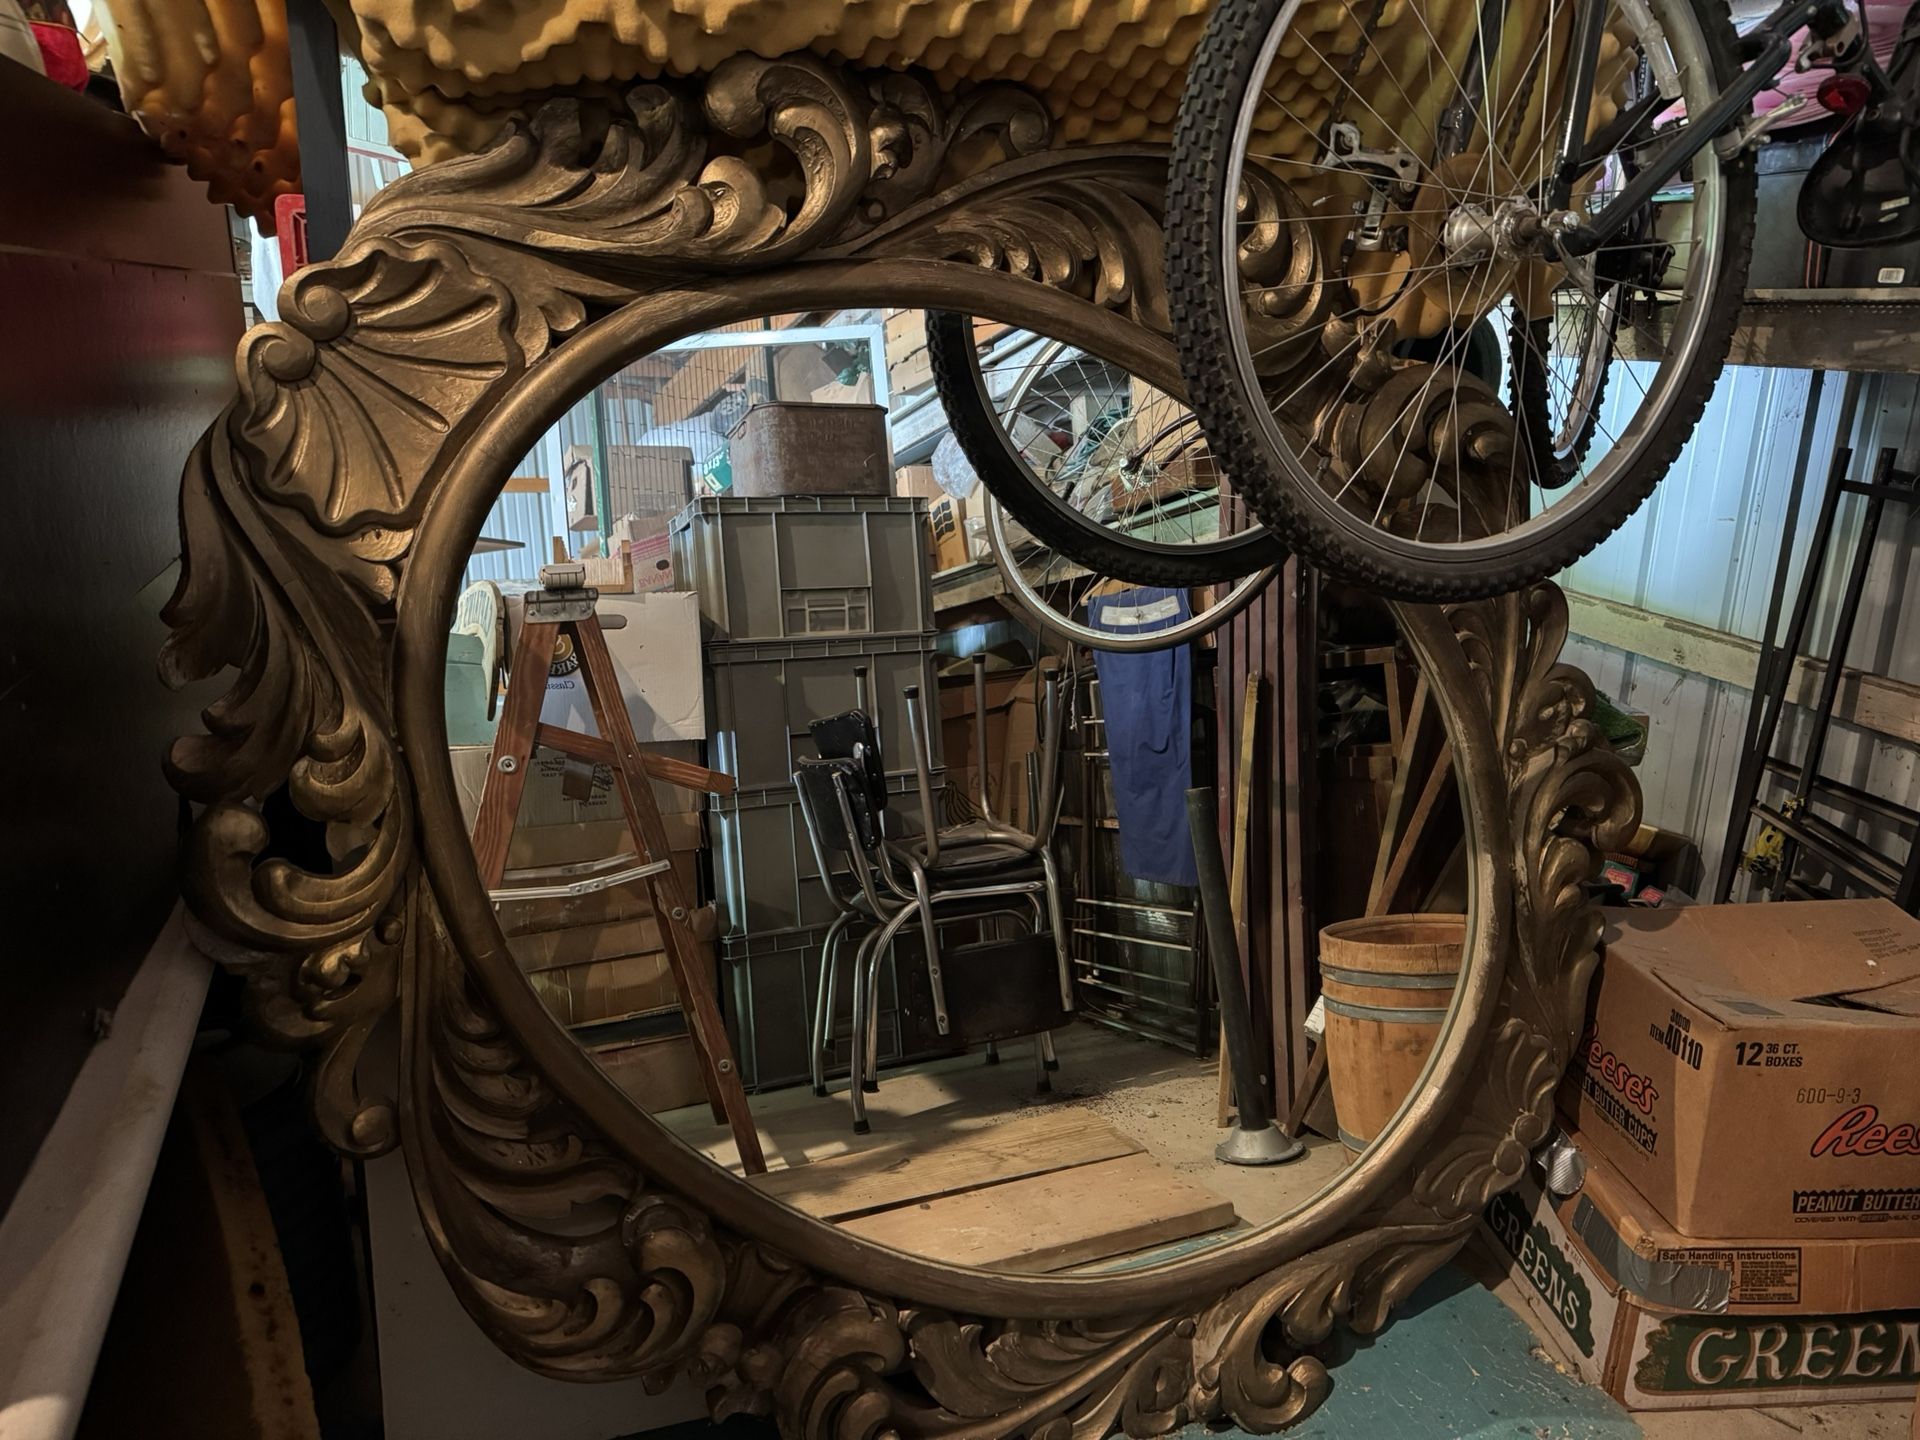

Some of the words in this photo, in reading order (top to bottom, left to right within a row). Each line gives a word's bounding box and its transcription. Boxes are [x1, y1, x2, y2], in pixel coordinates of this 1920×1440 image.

[1649, 1023, 1665, 1045] ITEM
[1664, 1023, 1704, 1071] 40110
[1735, 1041, 1764, 1066] 12
[1766, 1043, 1779, 1054] 36
[1783, 1043, 1800, 1054] CT.
[1765, 1056, 1803, 1067] BOXES
[1594, 1086, 1625, 1126] BUTTER
[1628, 1117, 1655, 1151] CUPS
[1810, 1104, 1920, 1158] Ree
[1796, 1195, 1858, 1212] PEANUT
[1862, 1194, 1920, 1211] BUTTER
[1491, 1197, 1580, 1329] GREENS
[1662, 1251, 1685, 1261] Safe
[1688, 1251, 1734, 1262] Handling
[1736, 1251, 1797, 1261] Instructions
